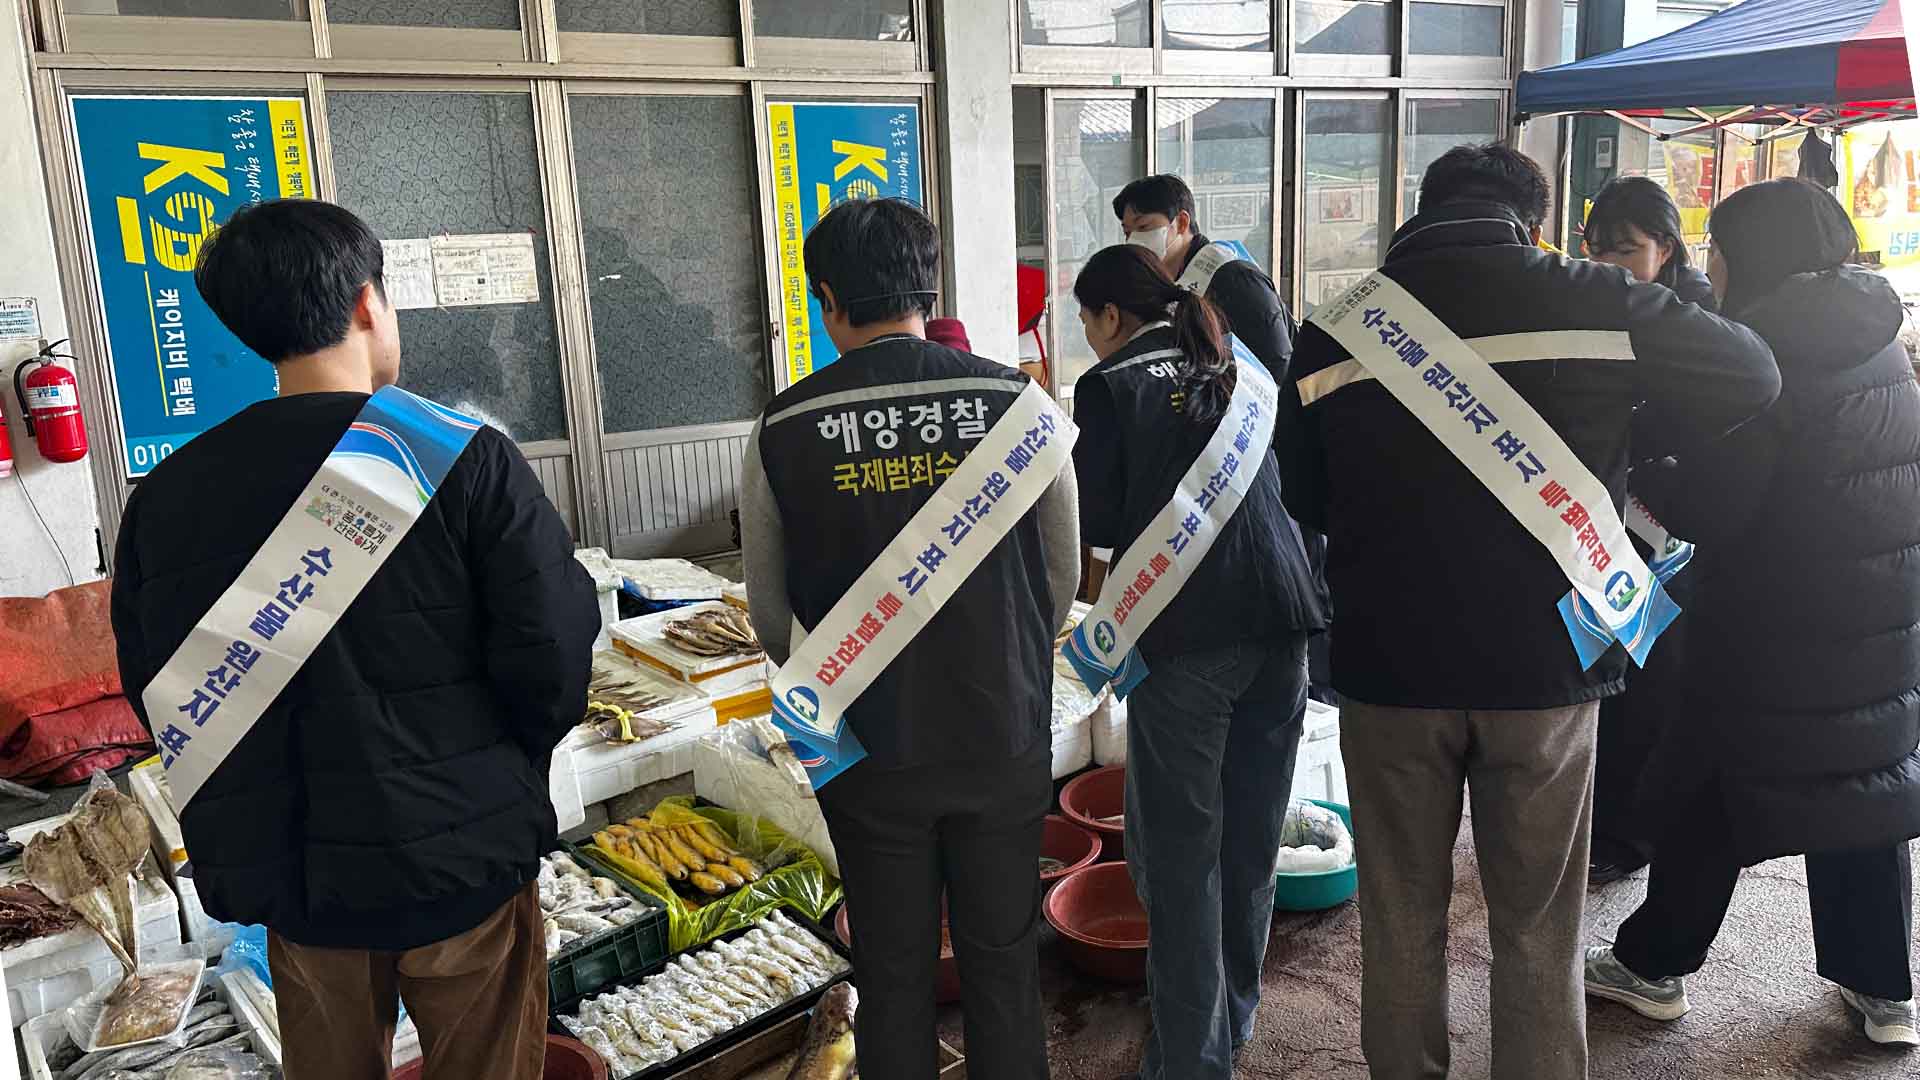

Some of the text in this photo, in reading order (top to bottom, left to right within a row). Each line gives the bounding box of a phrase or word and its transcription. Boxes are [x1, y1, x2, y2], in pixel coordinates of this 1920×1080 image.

[235, 157, 260, 203] 택배서
[892, 151, 910, 199] 택배서비
[156, 288, 196, 416] 케이지비 택배
[817, 397, 989, 454] 해양경찰
[1233, 401, 1259, 455] 수산물
[1362, 306, 1612, 573] 수산물 원산지 표시 특별점검
[832, 451, 960, 496] 국제범죄수
[1195, 452, 1240, 514] 원산지
[815, 413, 1056, 687] 수산물 원산지 표시 특별점검
[1166, 511, 1202, 555] 표시
[248, 547, 333, 641] 수산물
[1113, 552, 1171, 626] 특별점검
[177, 640, 262, 727] 원산지
